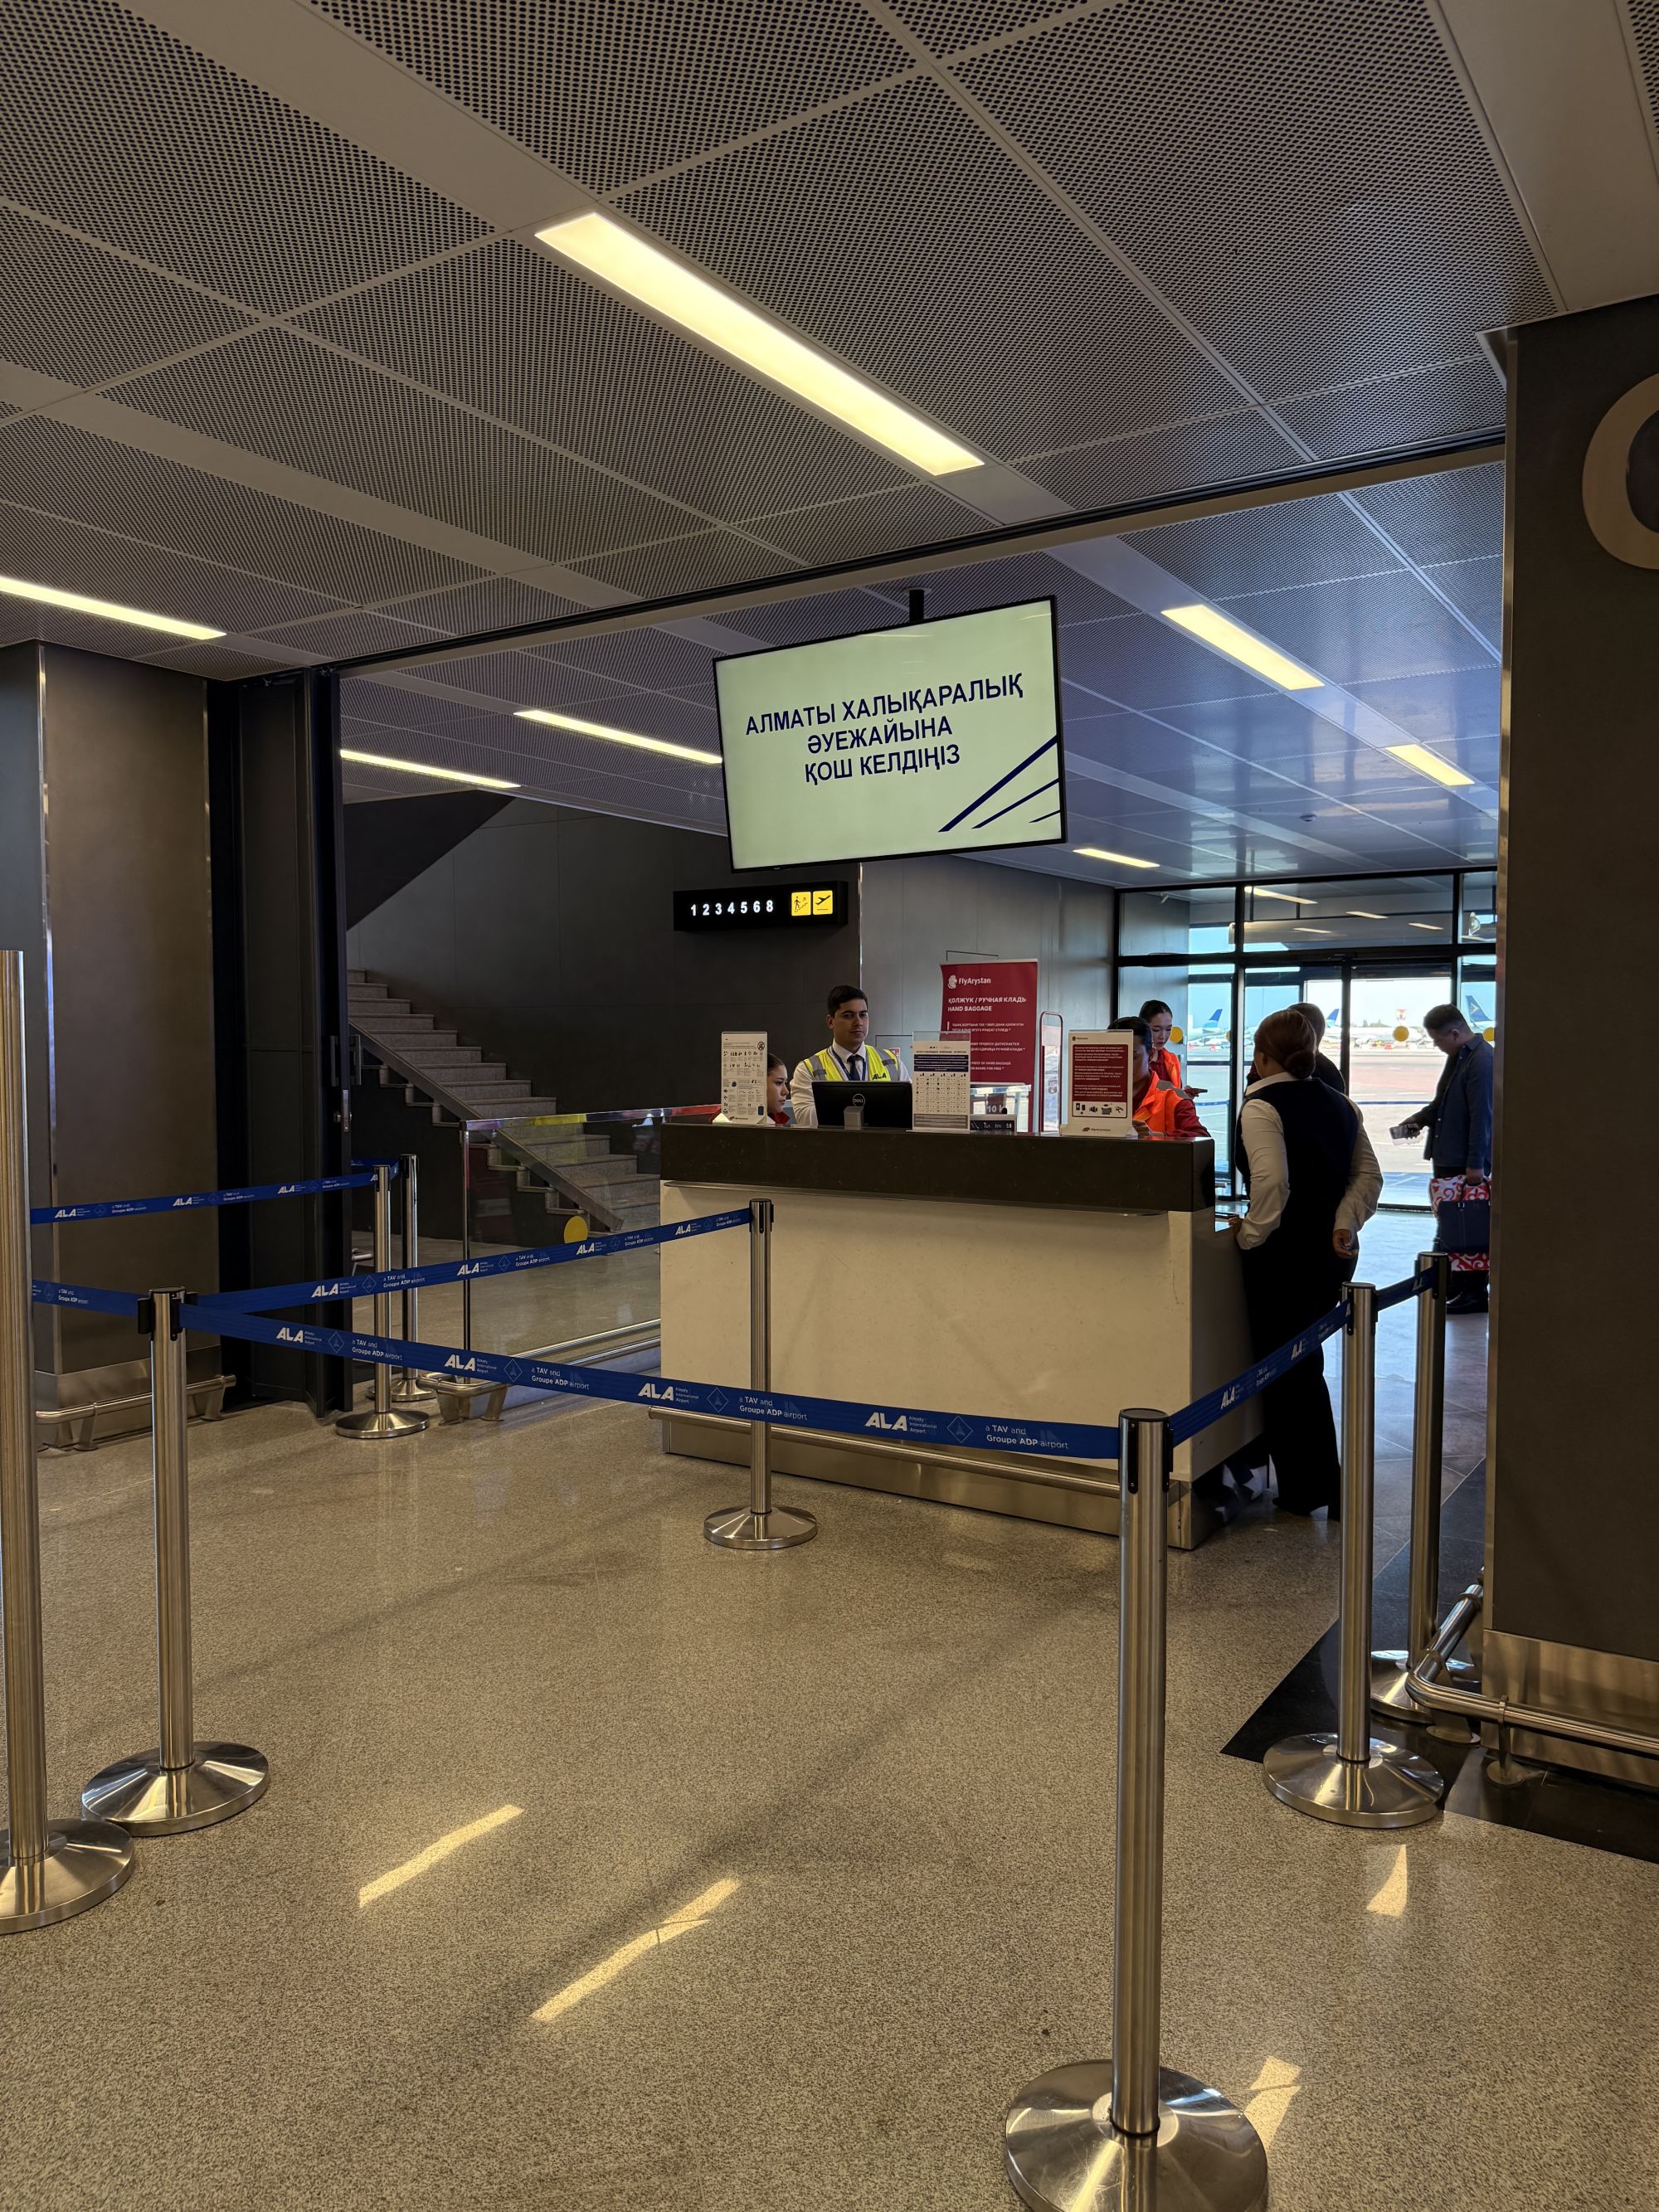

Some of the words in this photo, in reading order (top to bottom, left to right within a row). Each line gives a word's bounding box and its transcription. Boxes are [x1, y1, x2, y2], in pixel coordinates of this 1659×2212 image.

[745, 703, 836, 736] АЛМАТЫ
[842, 672, 1024, 722] ХАЛЫҚАРАЛЫҚ
[807, 716, 953, 754] ӘУЕЖАЙЫНА
[805, 759, 853, 786] ҚОШ
[859, 743, 961, 775] КЕЛДІҢІЗ
[690, 904, 697, 916] 1
[702, 903, 710, 916] 2
[715, 902, 722, 916] 3
[727, 902, 735, 914] 4
[740, 901, 748, 914] 5
[752, 900, 760, 913] 6
[766, 899, 774, 912] 8
[958, 977, 991, 986] FlyArystan
[277, 1184, 295, 1194] ALA
[173, 1197, 192, 1207] ALA
[54, 1208, 77, 1218] ALA
[675, 1223, 691, 1236] ALA
[577, 1242, 595, 1256] ALA
[457, 1262, 479, 1276] ALA
[311, 1283, 338, 1298] ALA
[276, 1327, 304, 1343] ALA
[352, 1346, 372, 1356] Groupe
[385, 1352, 402, 1361] airport
[1291, 1339, 1302, 1361] ALA
[444, 1354, 476, 1372] ALA
[549, 1369, 561, 1377] and
[532, 1375, 553, 1385] Groupe
[555, 1378, 568, 1386] ADP
[570, 1381, 590, 1391] airport
[637, 1383, 674, 1401] ALA
[1220, 1386, 1235, 1410] ALA
[745, 1396, 758, 1404] TAV
[739, 1405, 765, 1415] Groupe
[766, 1408, 782, 1417] ADP
[784, 1412, 808, 1420] airport
[864, 1412, 907, 1432] ALA
[991, 1425, 1008, 1433] TAV
[986, 1435, 1017, 1444] Groupe
[1040, 1440, 1069, 1450] airport
